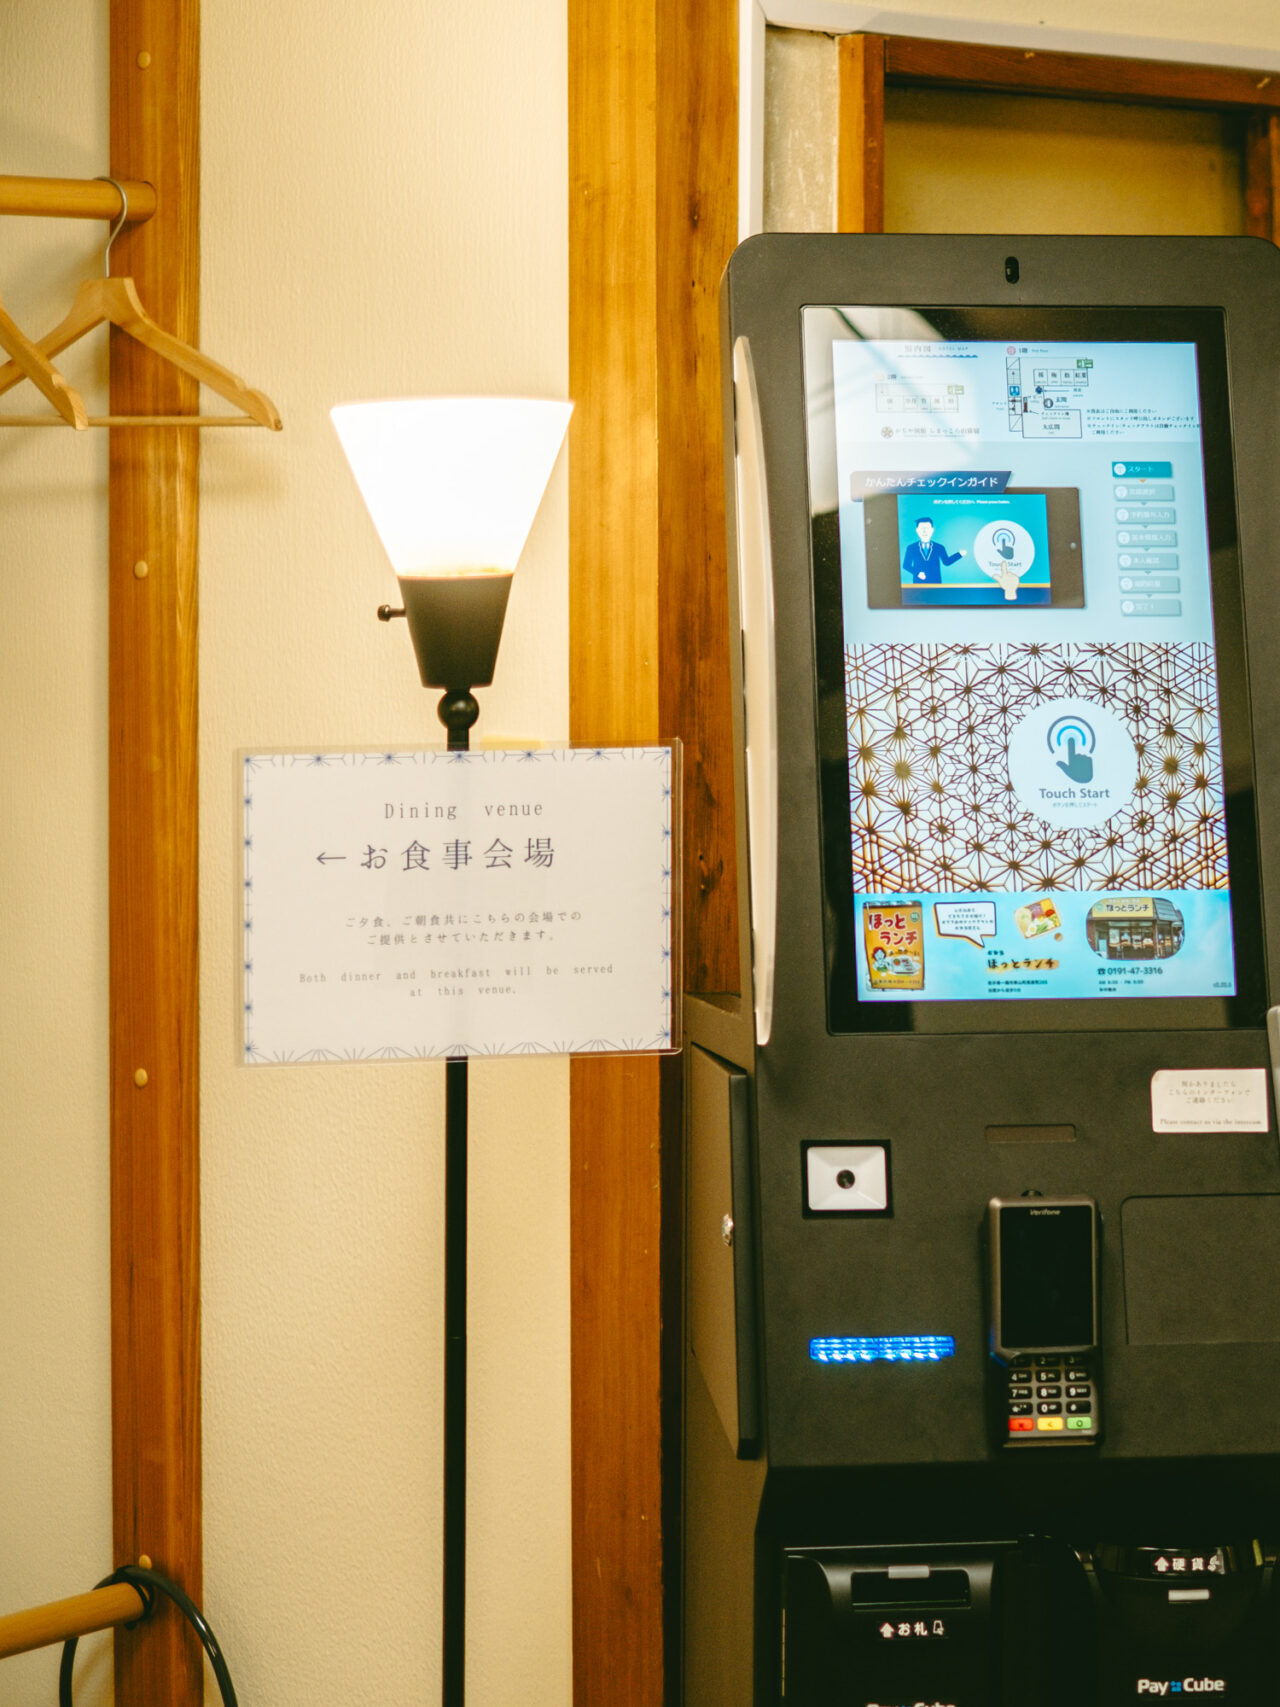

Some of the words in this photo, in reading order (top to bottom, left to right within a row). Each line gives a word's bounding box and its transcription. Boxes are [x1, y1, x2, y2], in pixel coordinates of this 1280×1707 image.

[865, 477, 999, 488] かんたんチェックインガイド
[1039, 788, 1076, 799] Touch
[1080, 788, 1110, 799] Start
[384, 802, 457, 820] Dining
[484, 803, 543, 816] venue
[360, 837, 555, 872] お食事会場
[868, 913, 906, 930] ほっと
[880, 931, 917, 945] ランチ
[987, 958, 1055, 968] ほっとランチ
[299, 972, 327, 983] Both
[341, 970, 381, 982] dinner
[396, 969, 416, 981] and
[430, 968, 490, 980] breakfast
[505, 965, 531, 977] will
[546, 965, 559, 976] be
[573, 963, 613, 975] served
[1107, 967, 1163, 975] 0191-47-3316
[409, 987, 422, 997] at
[437, 986, 464, 996] this
[478, 985, 516, 995] venue.
[1172, 1557, 1204, 1571] 硬貨
[898, 1622, 928, 1636] お札
[1137, 1679, 1168, 1696] Pay
[1183, 1677, 1225, 1692] Cube
